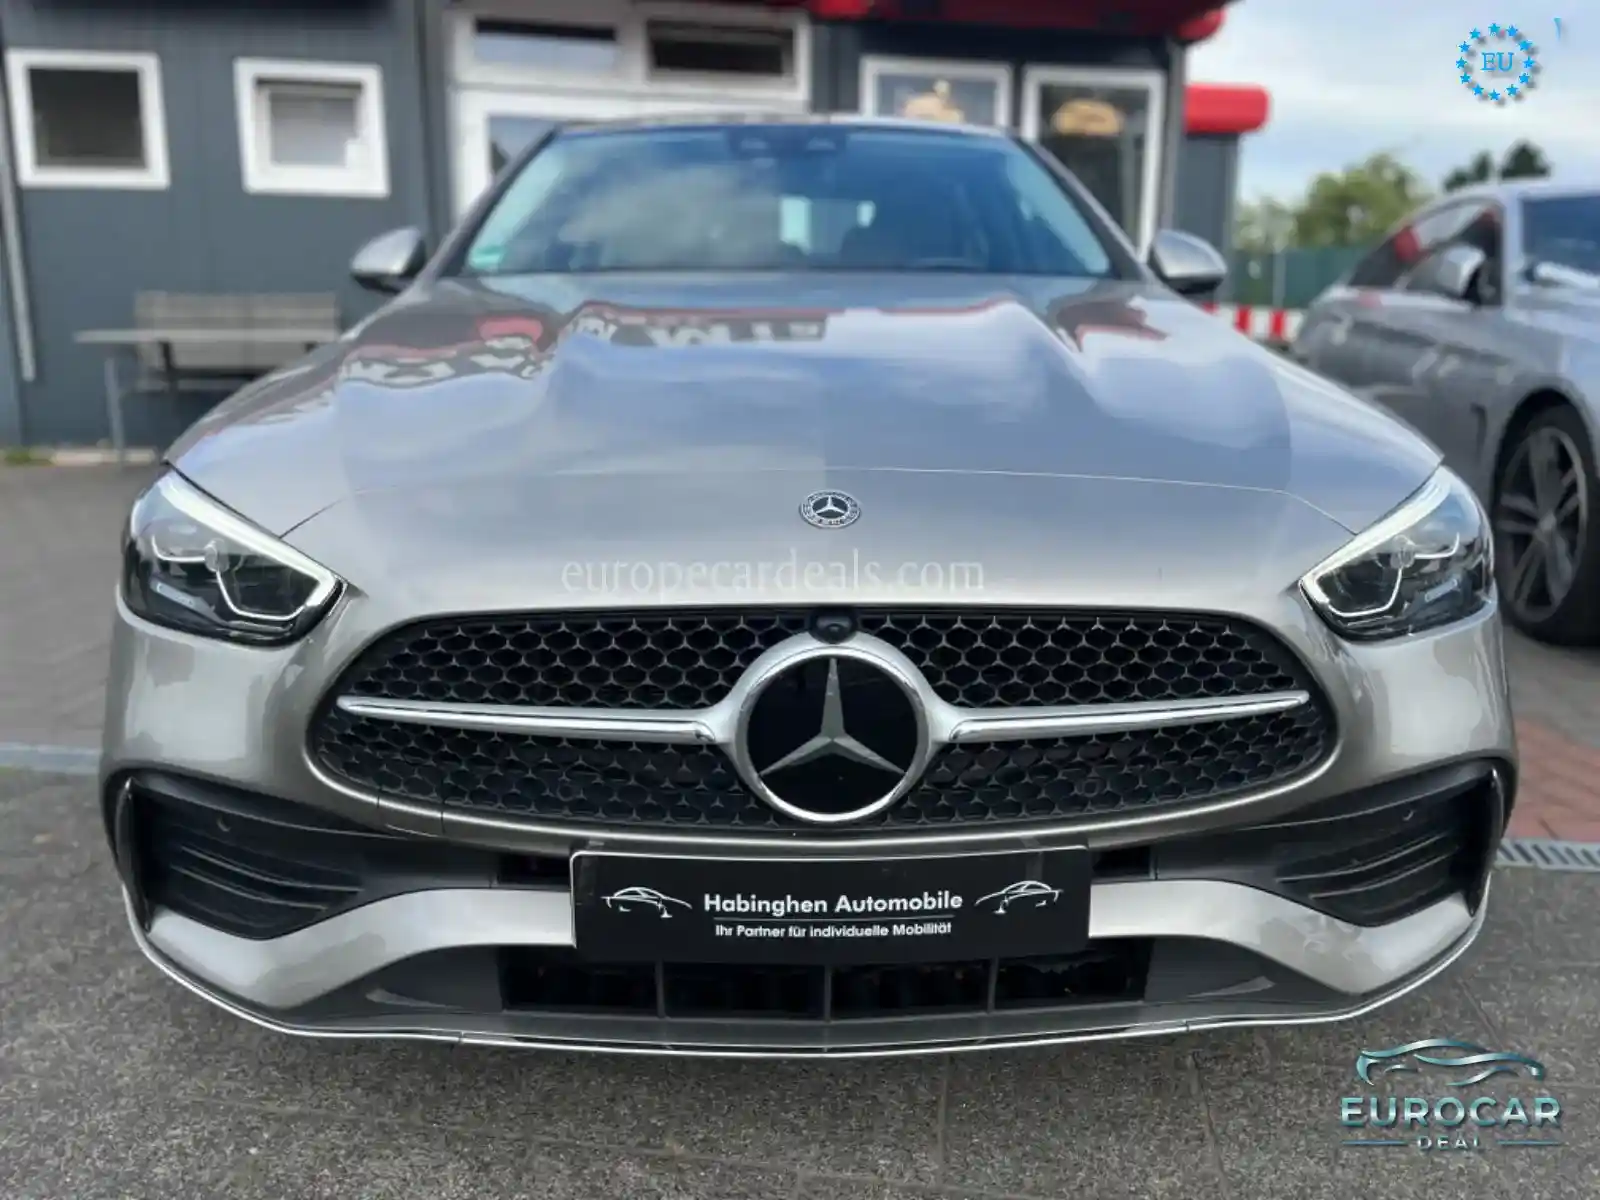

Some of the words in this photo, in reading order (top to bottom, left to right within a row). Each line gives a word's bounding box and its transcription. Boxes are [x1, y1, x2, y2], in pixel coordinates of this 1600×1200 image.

[704, 893, 828, 917] Habinghen
[834, 890, 963, 912] Automobile
[715, 924, 733, 937] Ihr
[736, 925, 786, 937] Partner
[788, 925, 807, 938] für
[809, 925, 890, 938] individuelle
[892, 921, 952, 936] Mobilität
